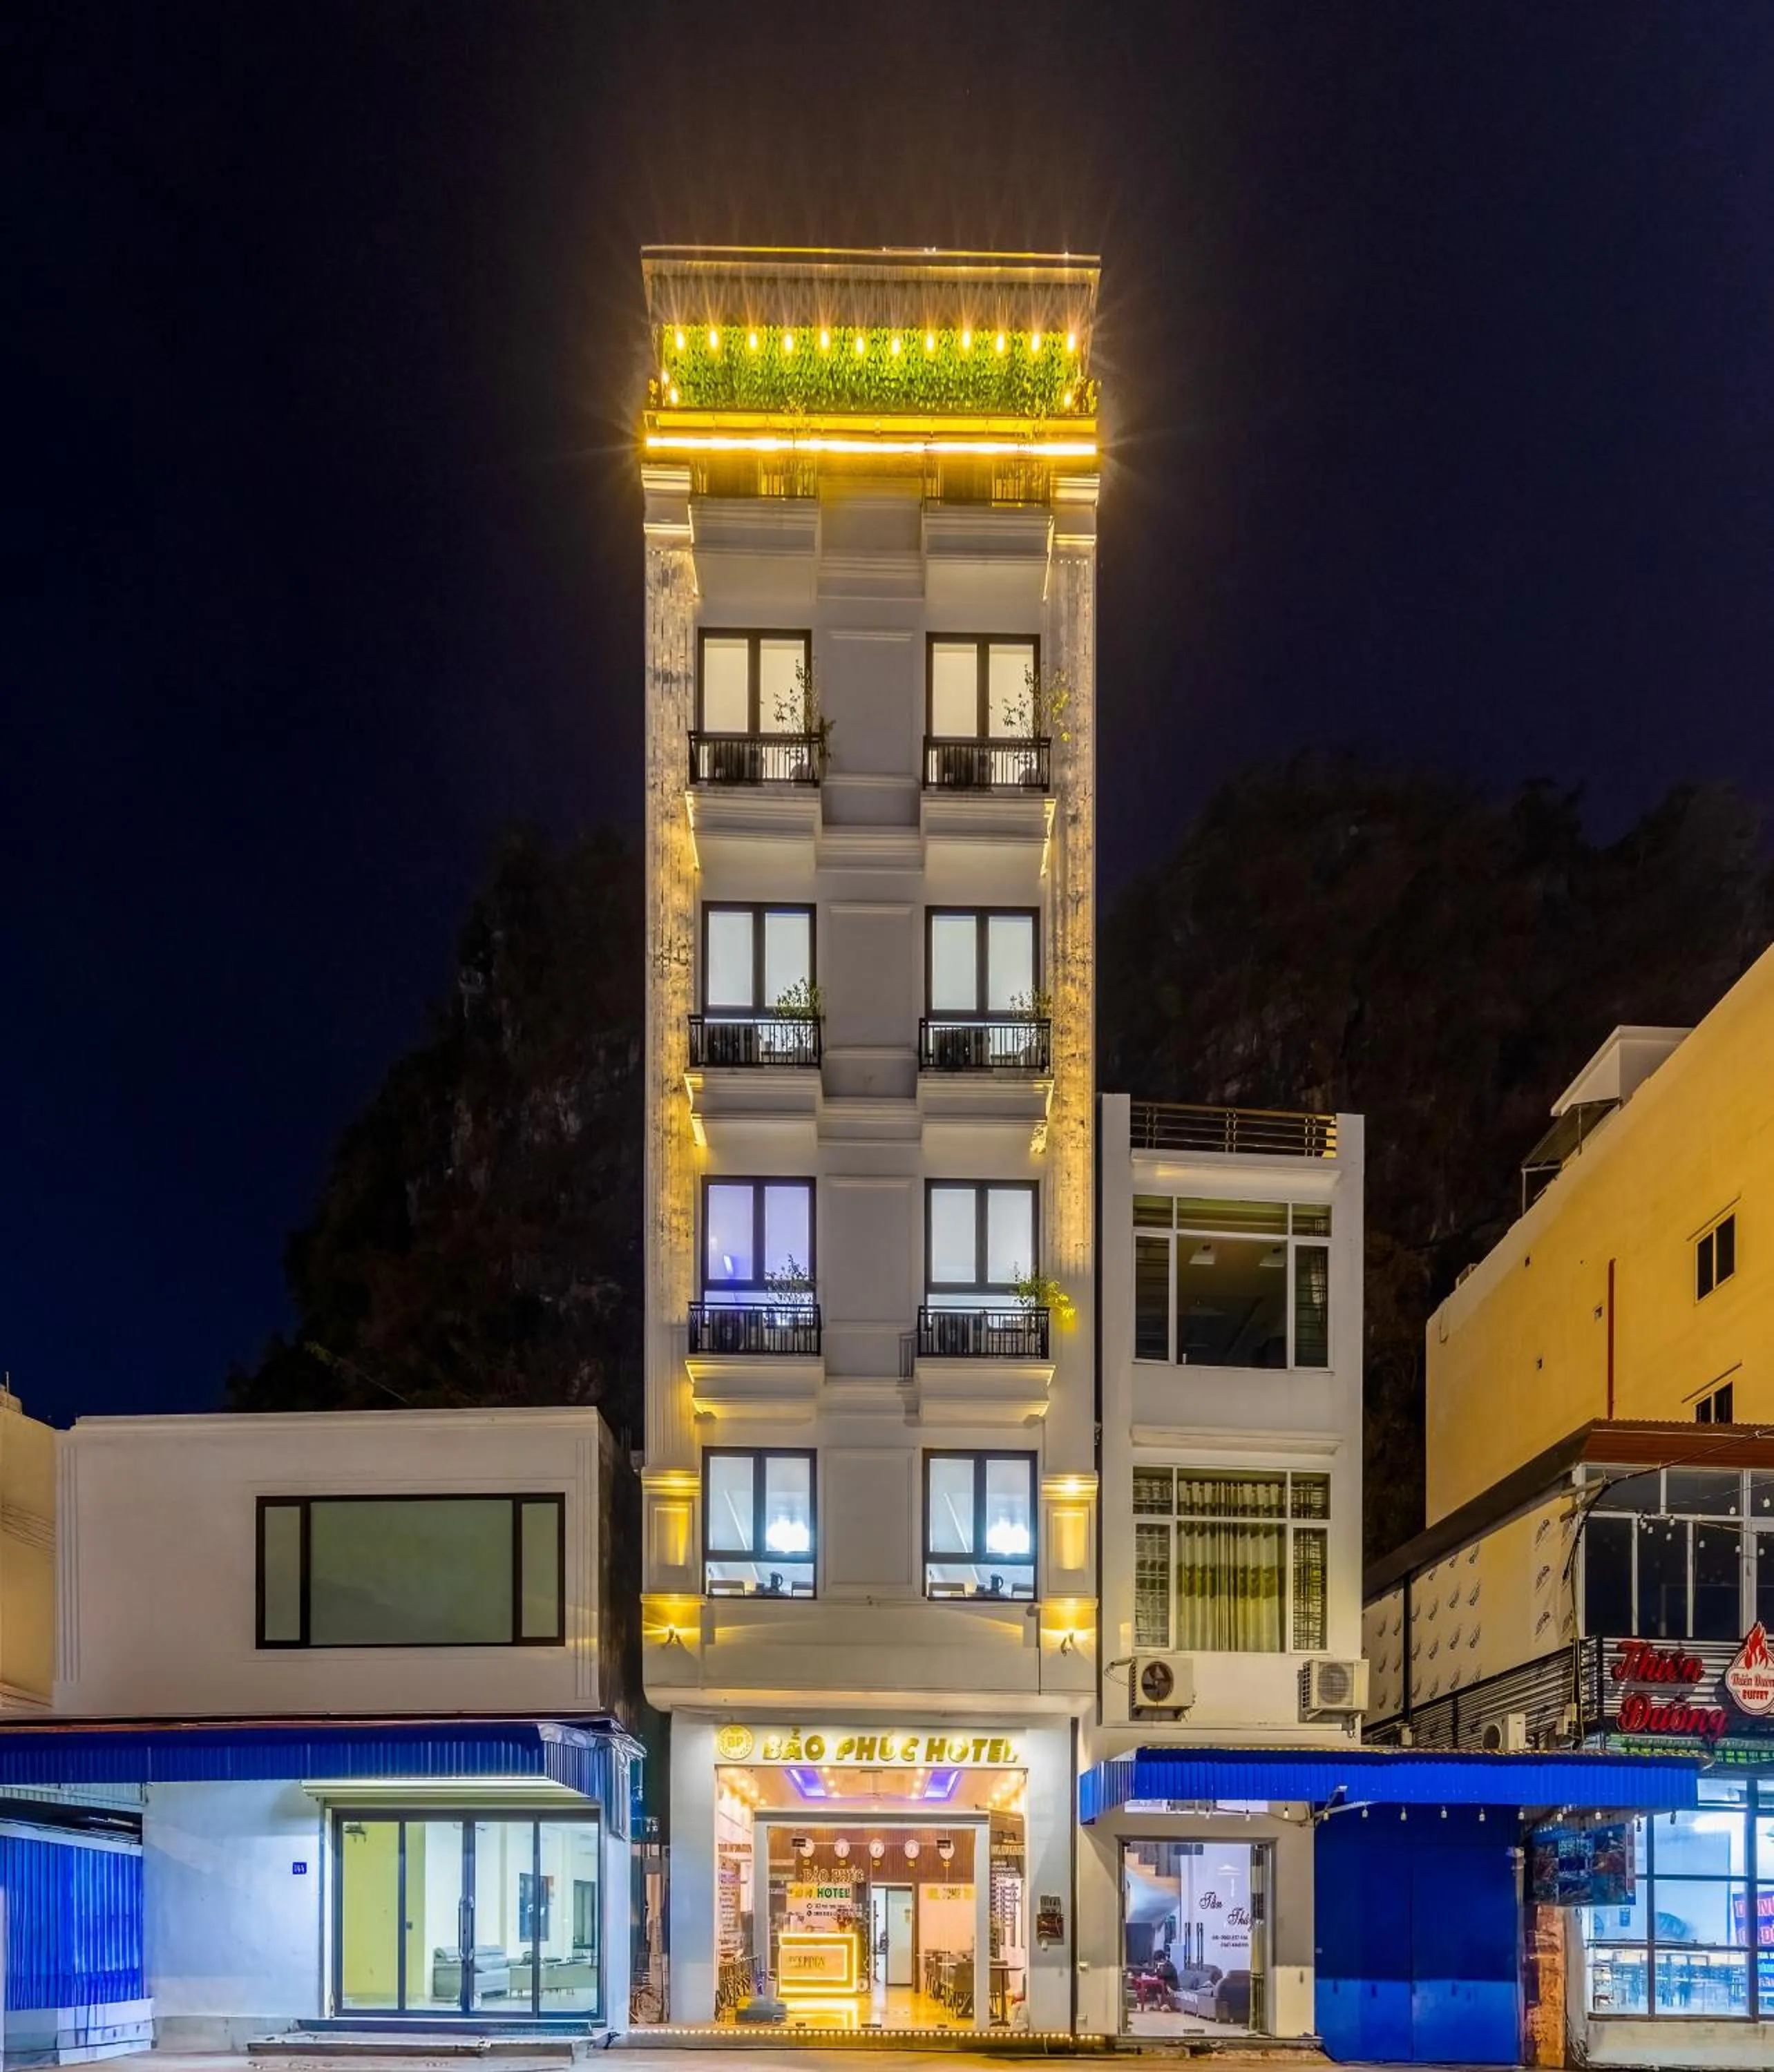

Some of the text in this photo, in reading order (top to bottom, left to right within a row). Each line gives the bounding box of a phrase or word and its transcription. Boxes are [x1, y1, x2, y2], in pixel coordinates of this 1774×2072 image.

[763, 1727, 1018, 1763] BẢO PHÚC HOTEL
[817, 1888, 850, 1899] HOTEL
